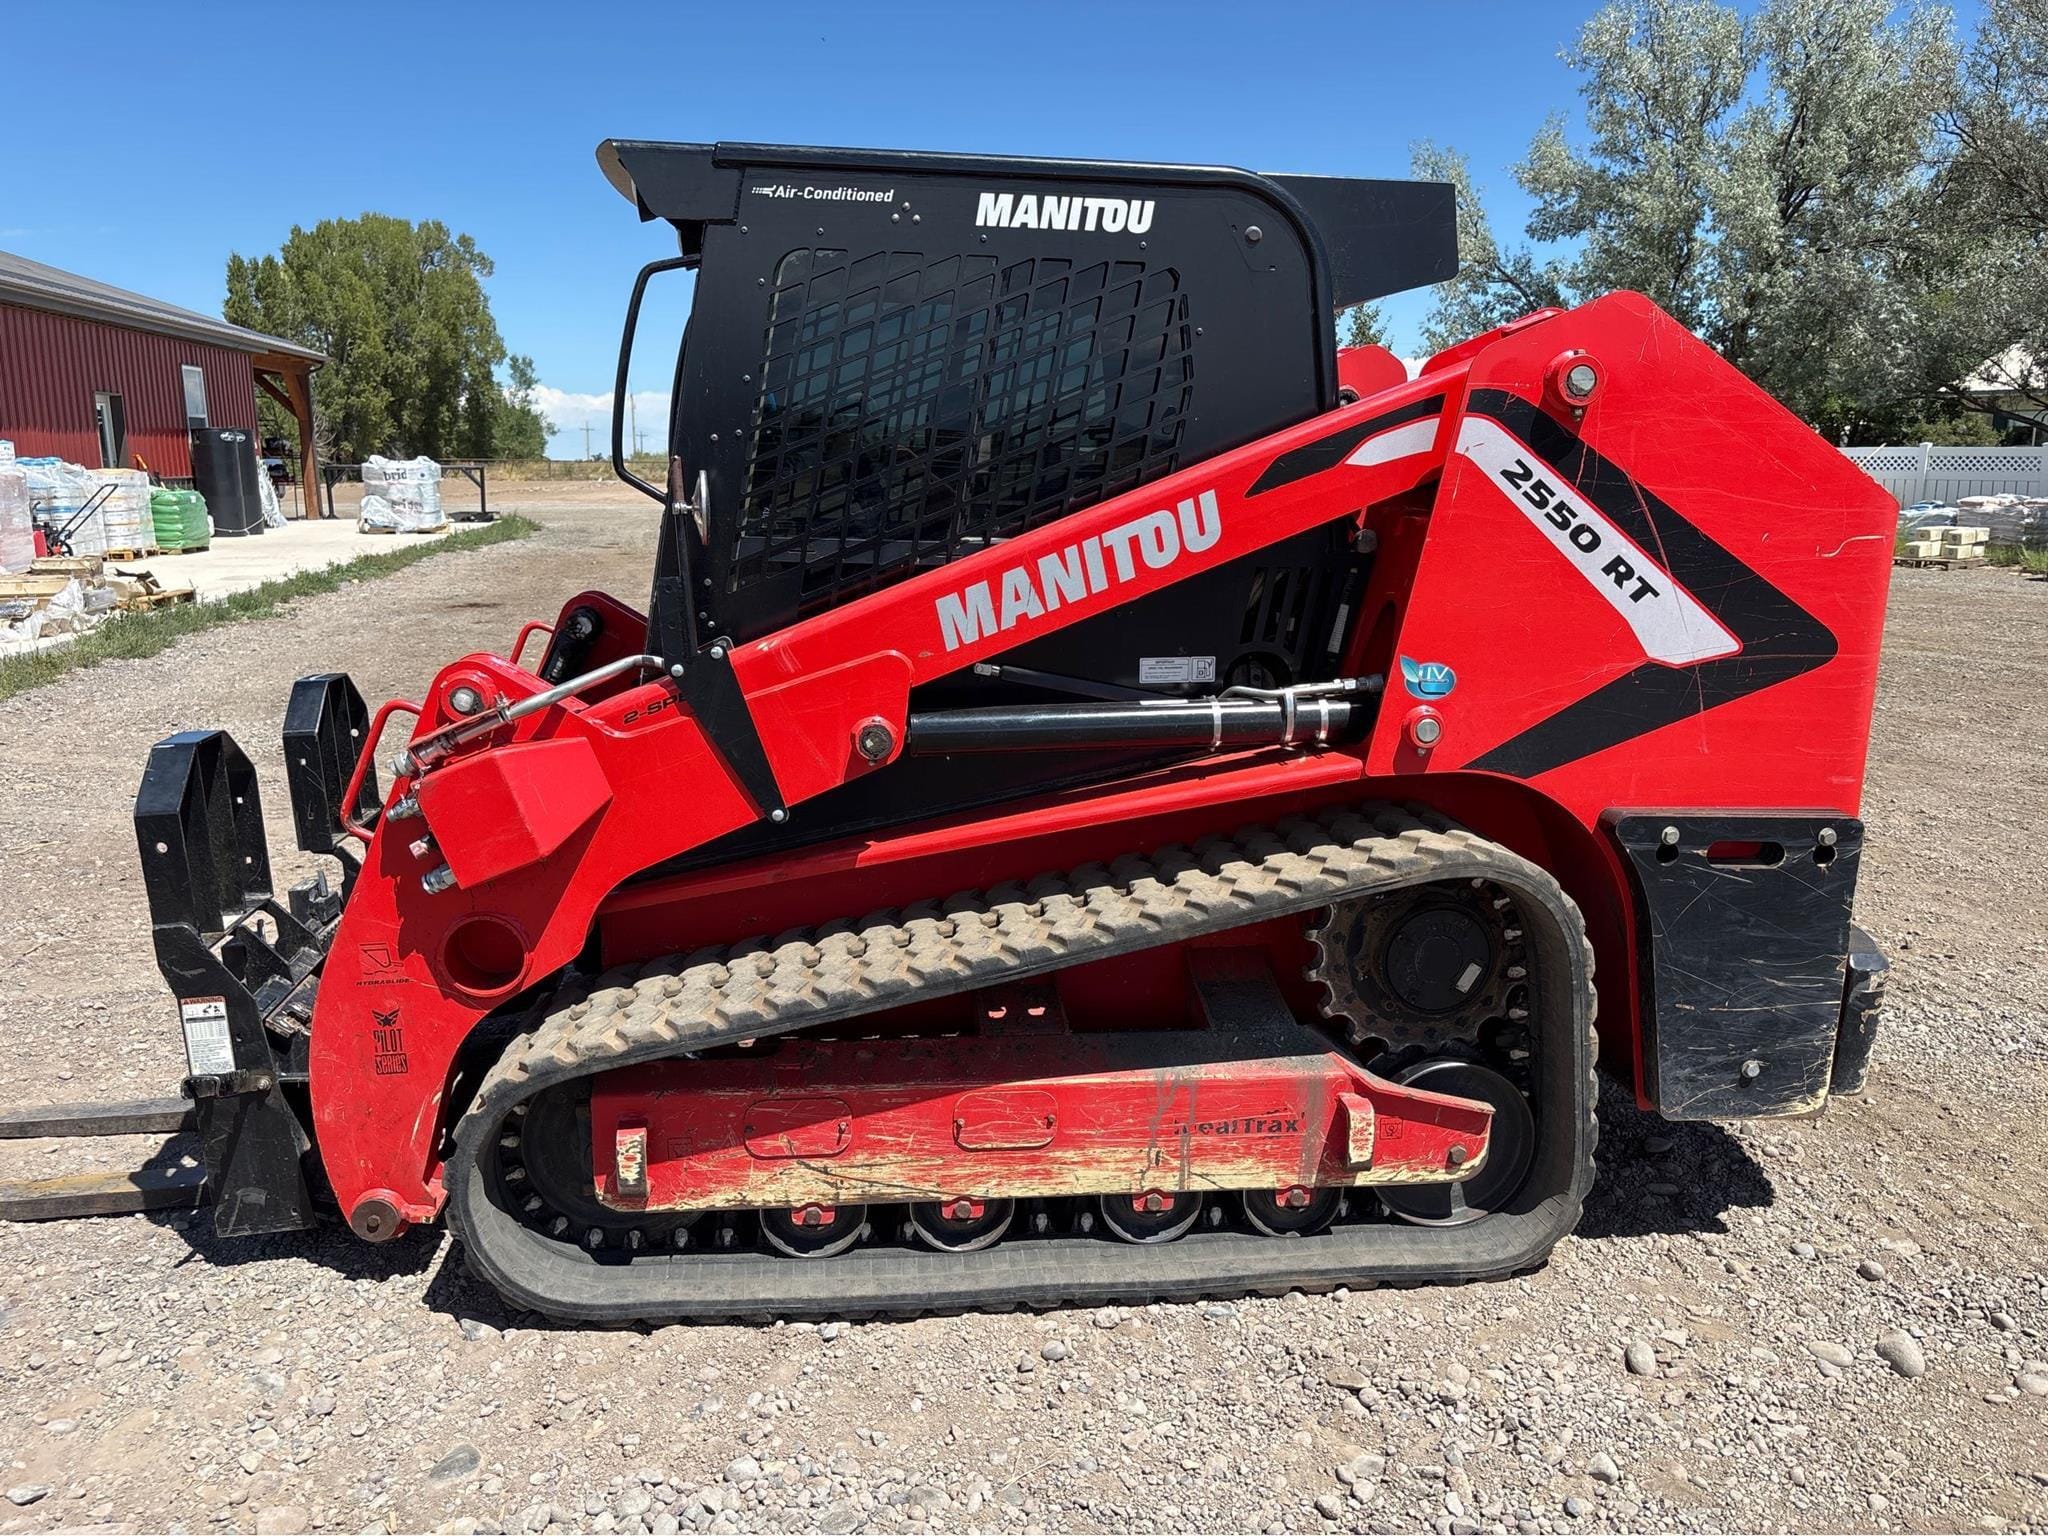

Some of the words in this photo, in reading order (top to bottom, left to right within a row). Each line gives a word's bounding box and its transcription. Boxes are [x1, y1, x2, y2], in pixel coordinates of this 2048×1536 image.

[774, 184, 895, 202] Air-Conditioned
[975, 192, 1155, 234] MANITOU
[935, 489, 1222, 652] MANITOU
[1499, 458, 1602, 554] 2550
[1601, 554, 1661, 604] RT
